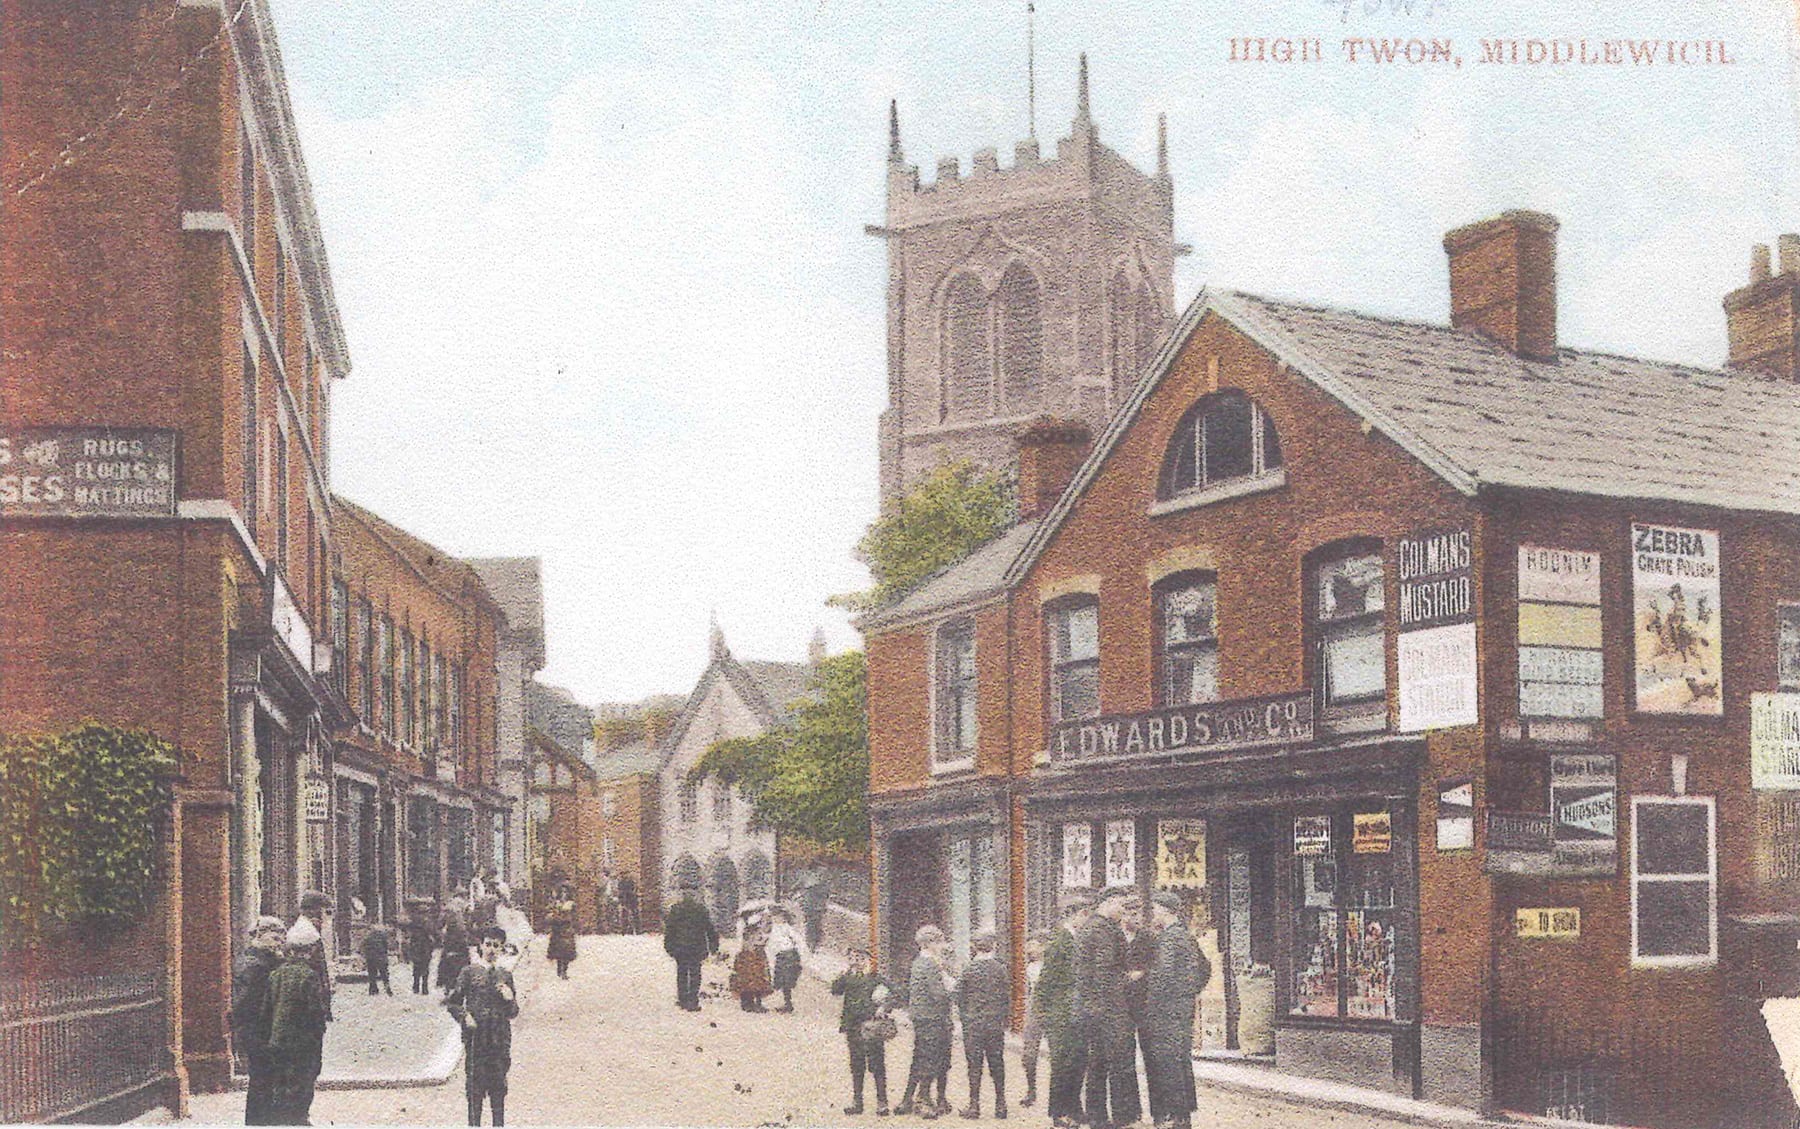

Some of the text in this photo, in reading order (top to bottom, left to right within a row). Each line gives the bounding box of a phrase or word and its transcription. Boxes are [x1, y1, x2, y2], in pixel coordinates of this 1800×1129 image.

[1634, 523, 1705, 557] ZEBRA
[1638, 554, 1673, 576] GRATE
[1400, 576, 1471, 625] MUSTARD
[1056, 712, 1211, 760] EDWARDS
